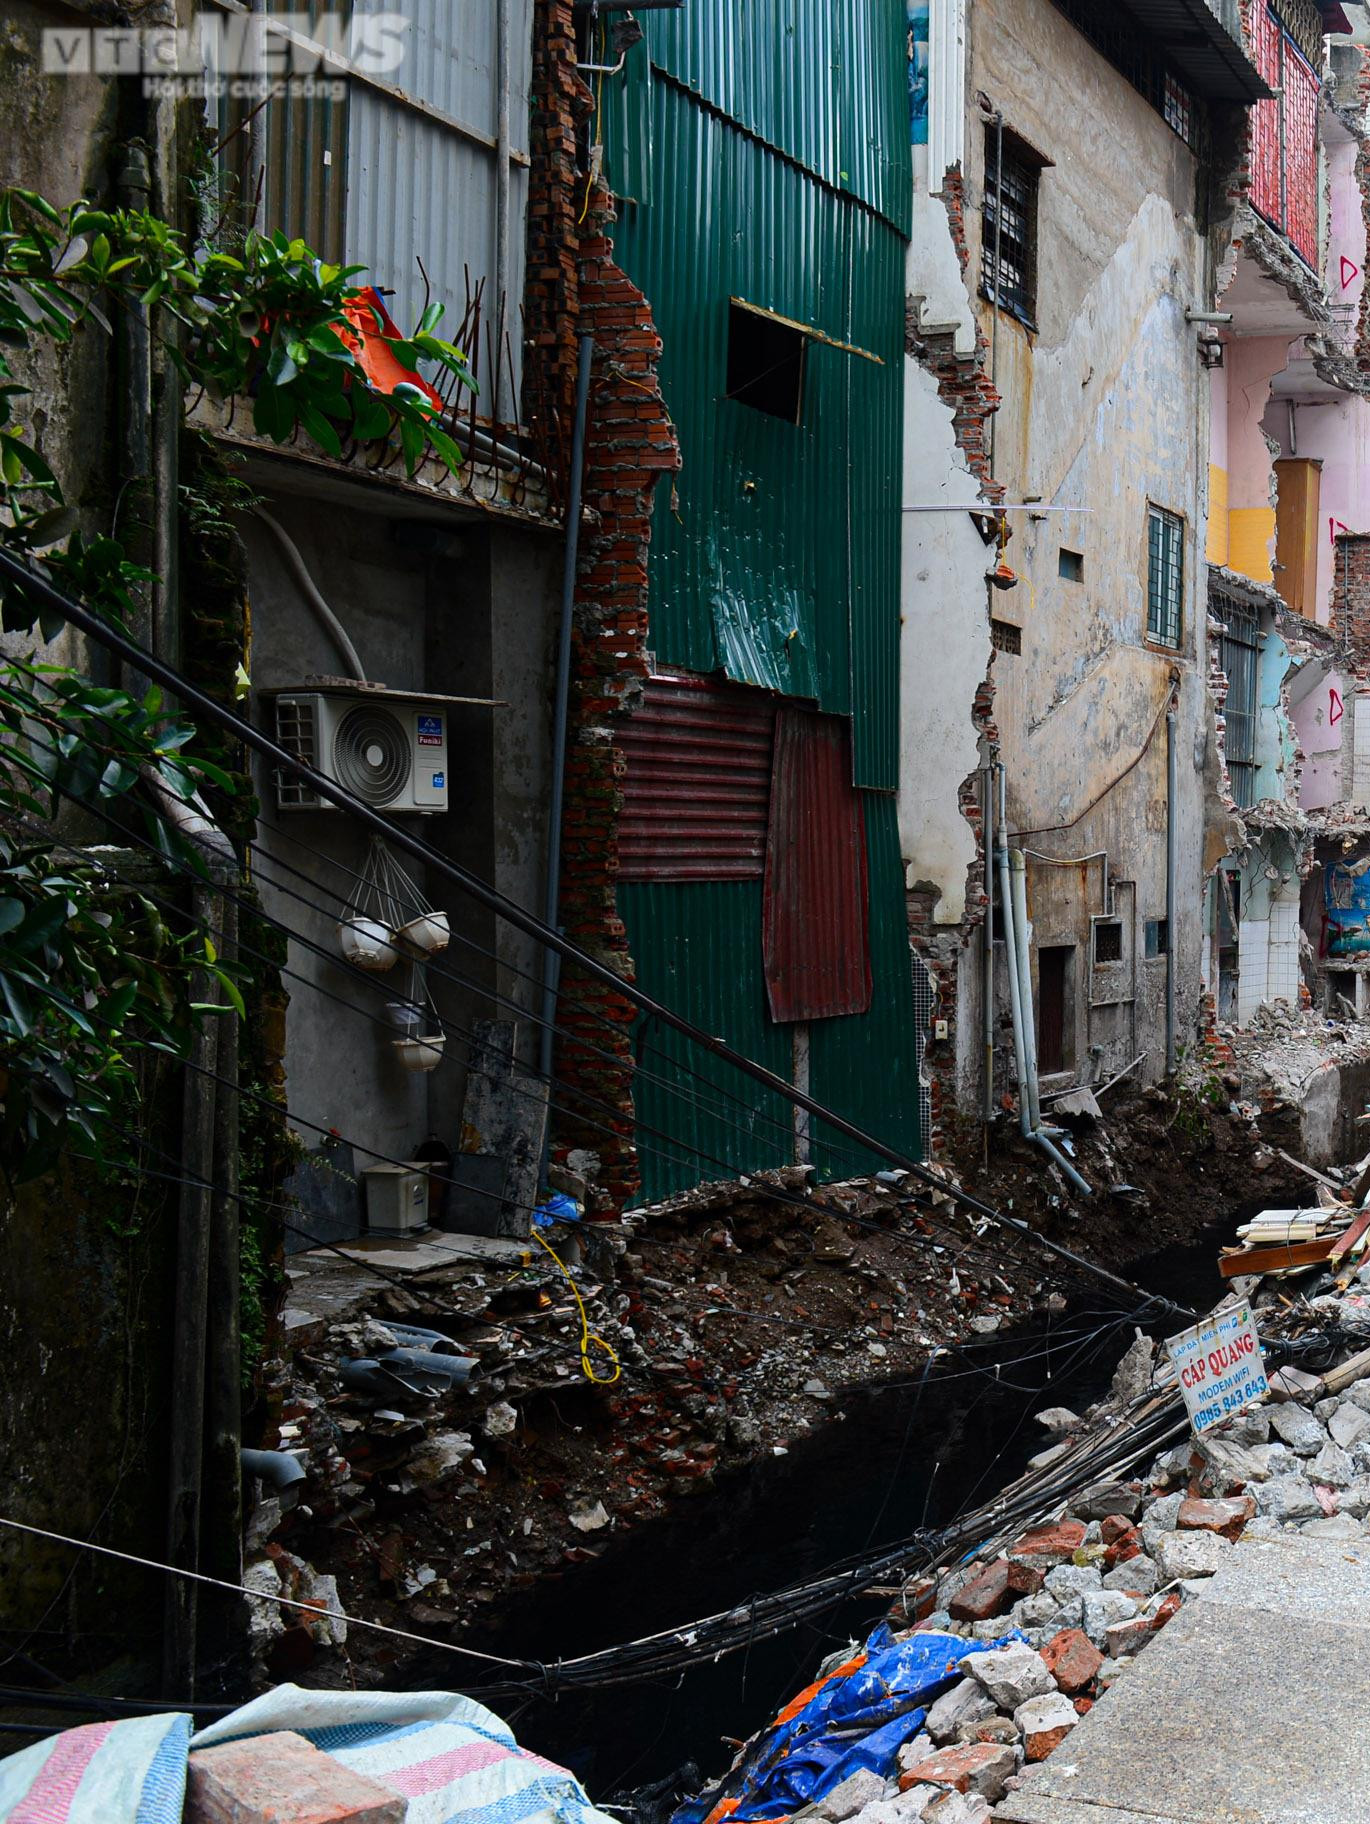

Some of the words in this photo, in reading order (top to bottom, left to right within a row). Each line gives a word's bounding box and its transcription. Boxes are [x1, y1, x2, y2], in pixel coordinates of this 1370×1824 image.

[1181, 1358, 1206, 1388] CÁP
[1208, 1333, 1254, 1377] QUANG
[1198, 1378, 1233, 1403] MODEM
[1232, 1366, 1250, 1384] WIFI
[1194, 1402, 1221, 1431] 0985
[1222, 1389, 1244, 1412] 843
